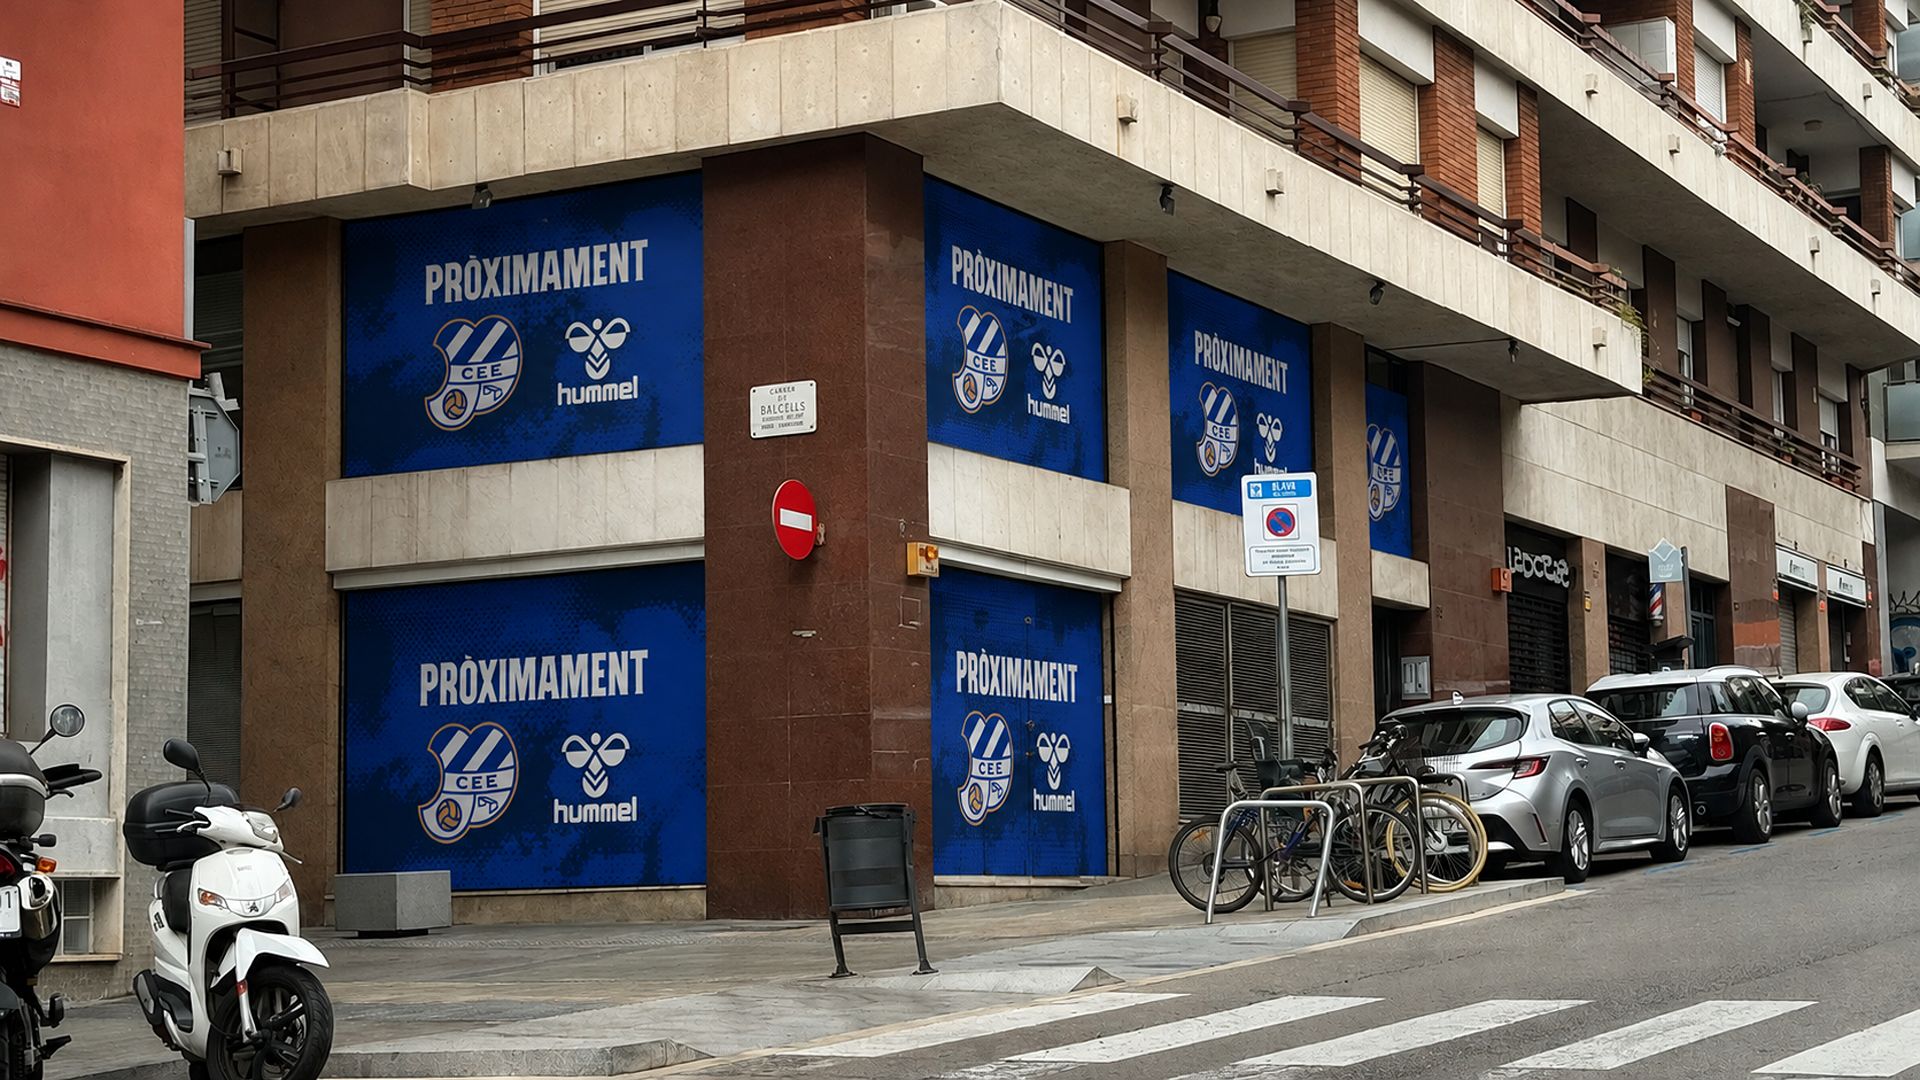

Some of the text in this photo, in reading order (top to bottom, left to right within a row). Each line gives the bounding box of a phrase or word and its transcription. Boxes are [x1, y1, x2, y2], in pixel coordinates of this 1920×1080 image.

[425, 239, 648, 305] PRÒXIMAMENT
[952, 245, 1073, 324] PRÒXIMAMENT
[461, 364, 502, 380] CEE
[973, 357, 996, 372] CEE
[1194, 330, 1288, 394] PRÒXIMAMENT
[557, 375, 638, 406] hummel
[761, 401, 805, 415] BALCELLS
[1027, 393, 1070, 424] hummel
[1212, 425, 1230, 439] CEE
[420, 649, 648, 706] PRÒXIMAMENT
[956, 648, 1078, 703] PRÒXIMAMENT
[978, 762, 1003, 775] CEE
[455, 775, 498, 790] CEE
[554, 796, 637, 823] hummel
[1033, 788, 1075, 812] hummel
